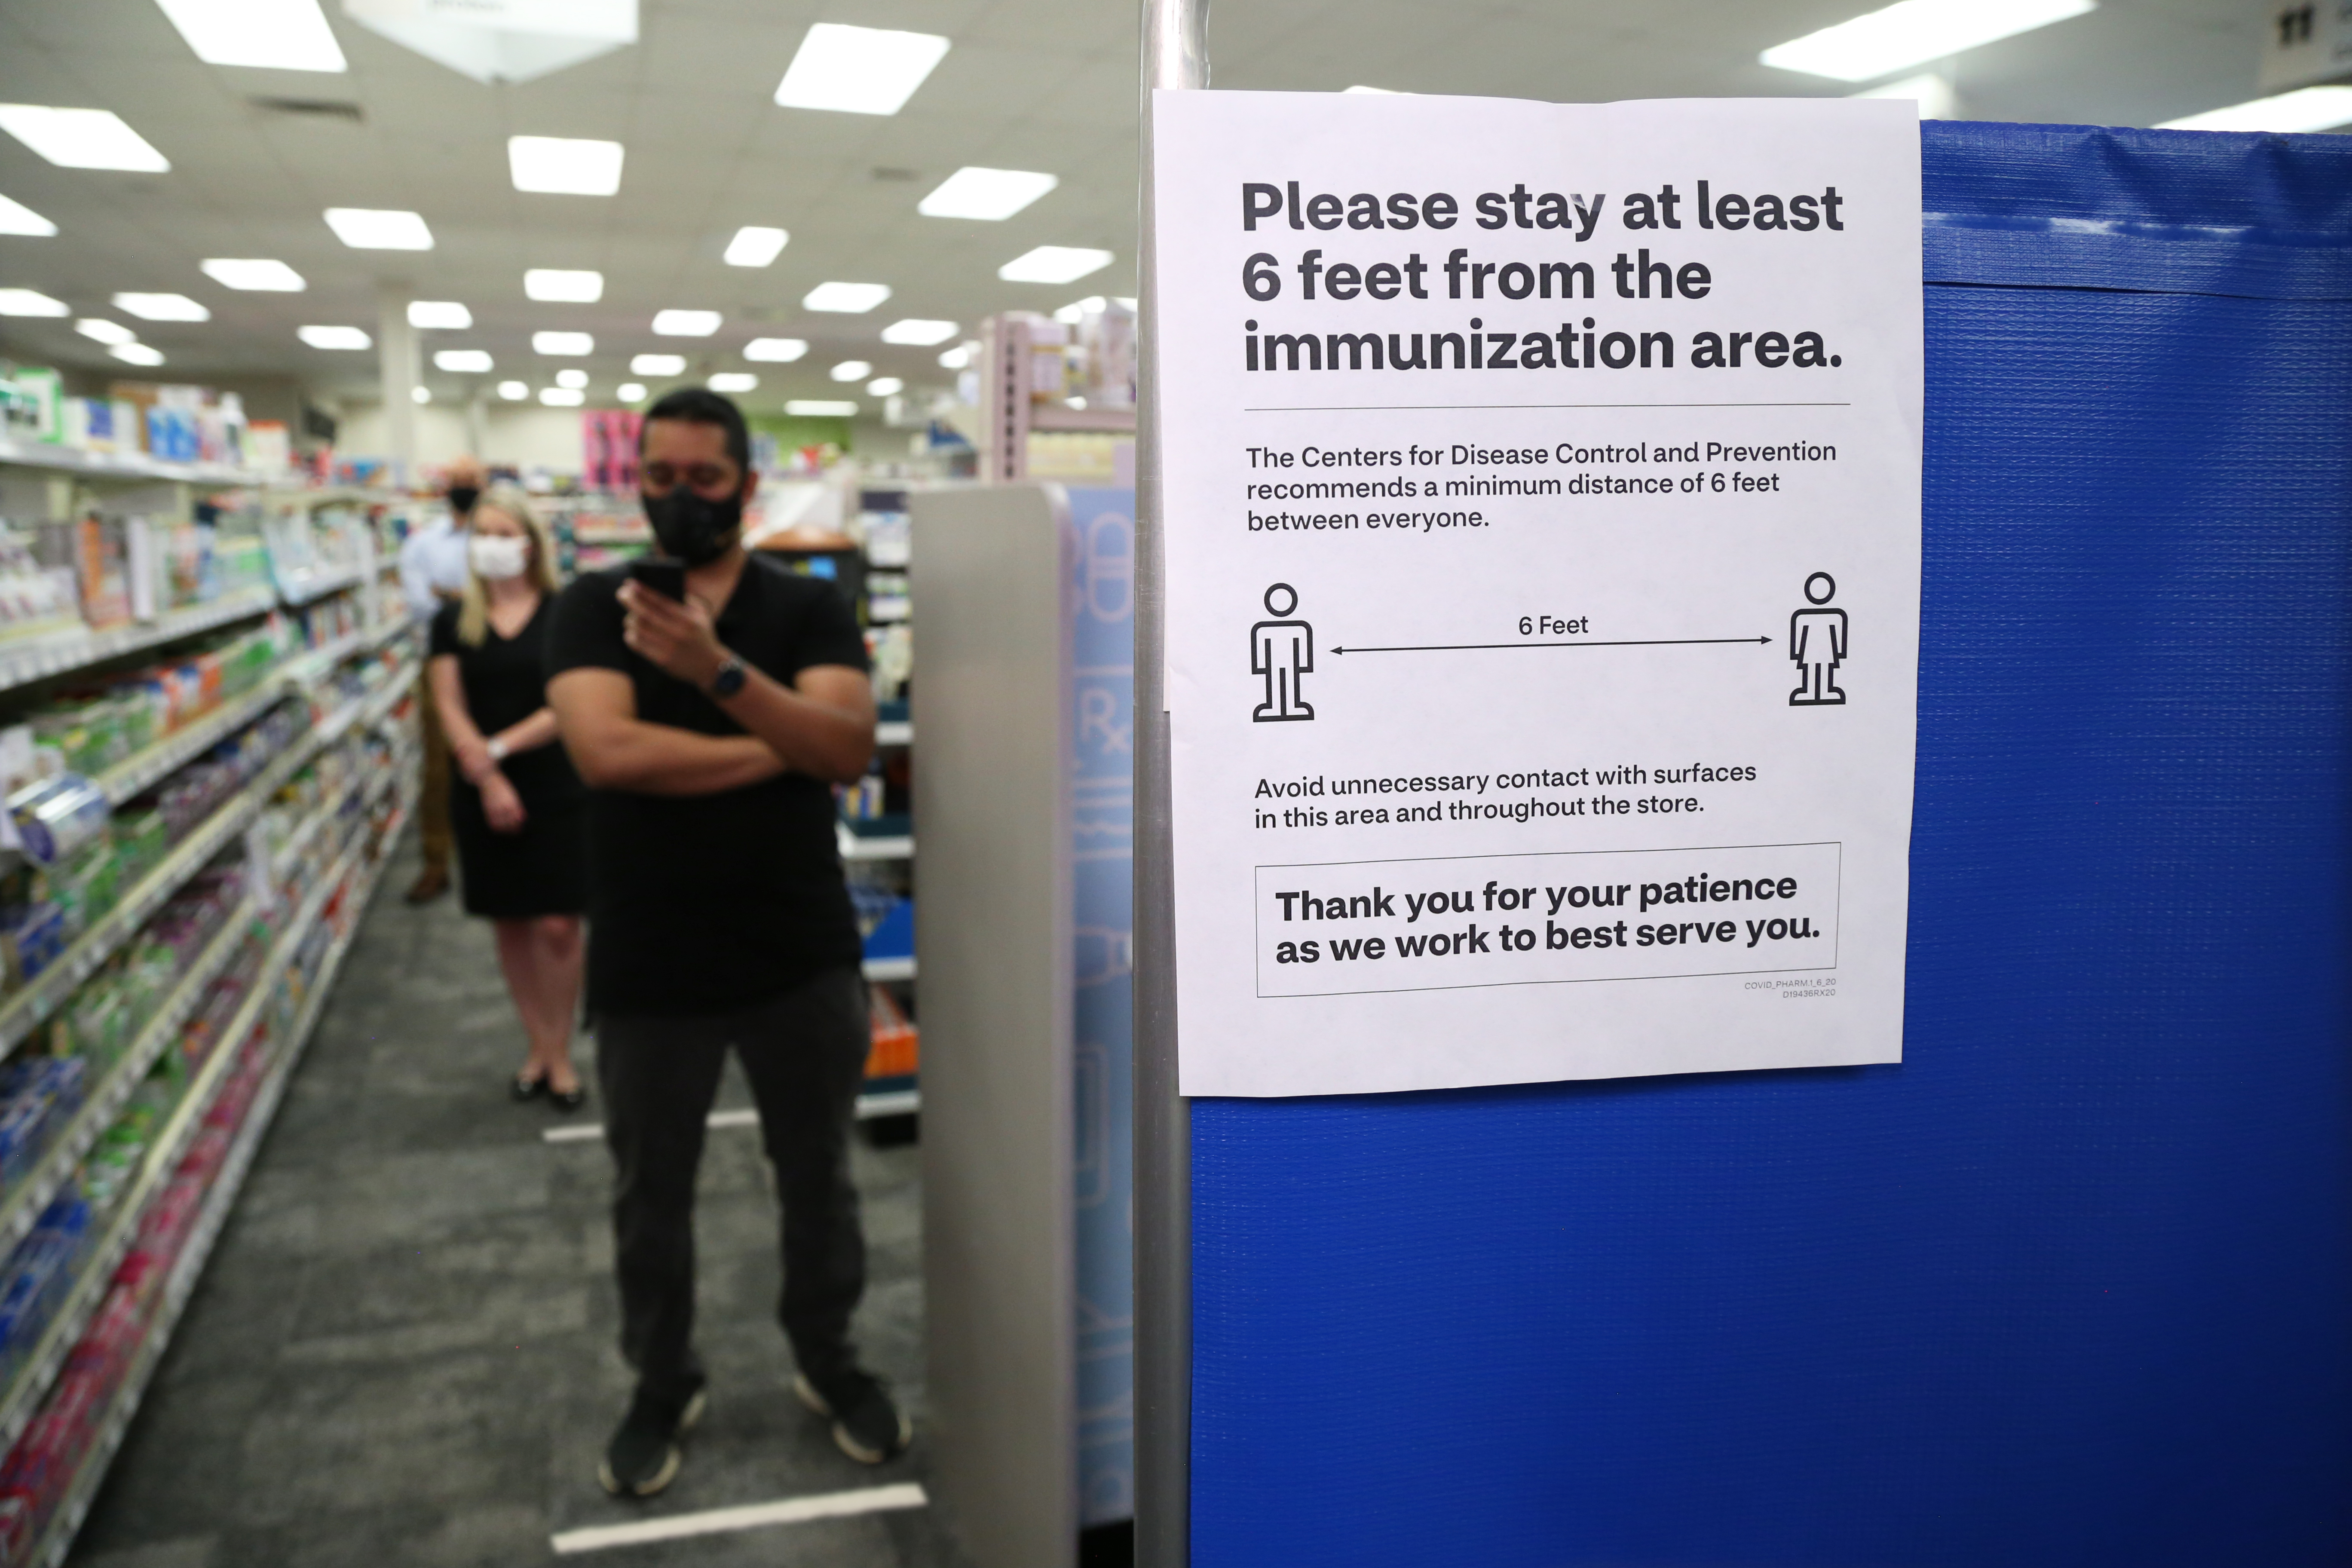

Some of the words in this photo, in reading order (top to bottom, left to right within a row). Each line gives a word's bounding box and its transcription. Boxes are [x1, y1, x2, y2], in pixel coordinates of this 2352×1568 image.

[1242, 181, 1458, 231] Please
[1475, 184, 1606, 242] stay
[1623, 184, 1681, 230] at
[1697, 180, 1844, 232] least
[1242, 252, 1281, 302] 6
[1297, 249, 1428, 300] feet
[1443, 248, 1595, 300] from
[1611, 248, 1712, 300] the
[1245, 317, 1674, 371] immunization
[1690, 331, 1842, 369] area.
[1246, 447, 1294, 468] The
[1302, 446, 1403, 468] Centers
[1409, 444, 1444, 466] for
[1452, 444, 1549, 465] Disease
[1556, 442, 1647, 464] Control
[1653, 441, 1700, 463] and
[1707, 440, 1836, 462] Prevention
[1247, 476, 1417, 500] recommends
[1424, 481, 1439, 497] a
[1446, 474, 1561, 496] minimum
[1568, 473, 1673, 495] distance
[1680, 472, 1705, 493] of
[1711, 472, 1726, 493] 6
[1732, 471, 1780, 493] feet
[1248, 510, 1359, 531] between
[1366, 511, 1489, 533] everyone.
[1519, 616, 1533, 635] 6
[1540, 616, 1589, 634] Feet
[1254, 775, 1325, 799] Avoid
[1332, 775, 1490, 796] unnecessary
[1496, 768, 1589, 789] contact
[1595, 764, 1647, 785] with
[1654, 762, 1756, 784] surfaces
[1255, 808, 1276, 829] in
[1283, 806, 1328, 827] this
[1335, 808, 1390, 826] area
[1396, 800, 1442, 823] and
[1448, 797, 1585, 823] throughout
[1591, 795, 1630, 815] the
[1637, 795, 1704, 814] store.
[1275, 886, 1396, 921] Thank
[1404, 891, 1475, 923] you
[1482, 881, 1537, 911] for
[1545, 884, 1631, 916] your
[1640, 872, 1798, 913] patience
[1276, 940, 1320, 964] as
[1329, 937, 1386, 961] we
[1394, 923, 1491, 958] work
[1498, 925, 1537, 952] to
[1546, 920, 1628, 950] best
[1636, 921, 1736, 947] serve
[1745, 917, 1820, 948] you.
[1744, 978, 1836, 990] COVID_PHARM.1_6_20
[1783, 989, 1836, 998] D19436RX20
